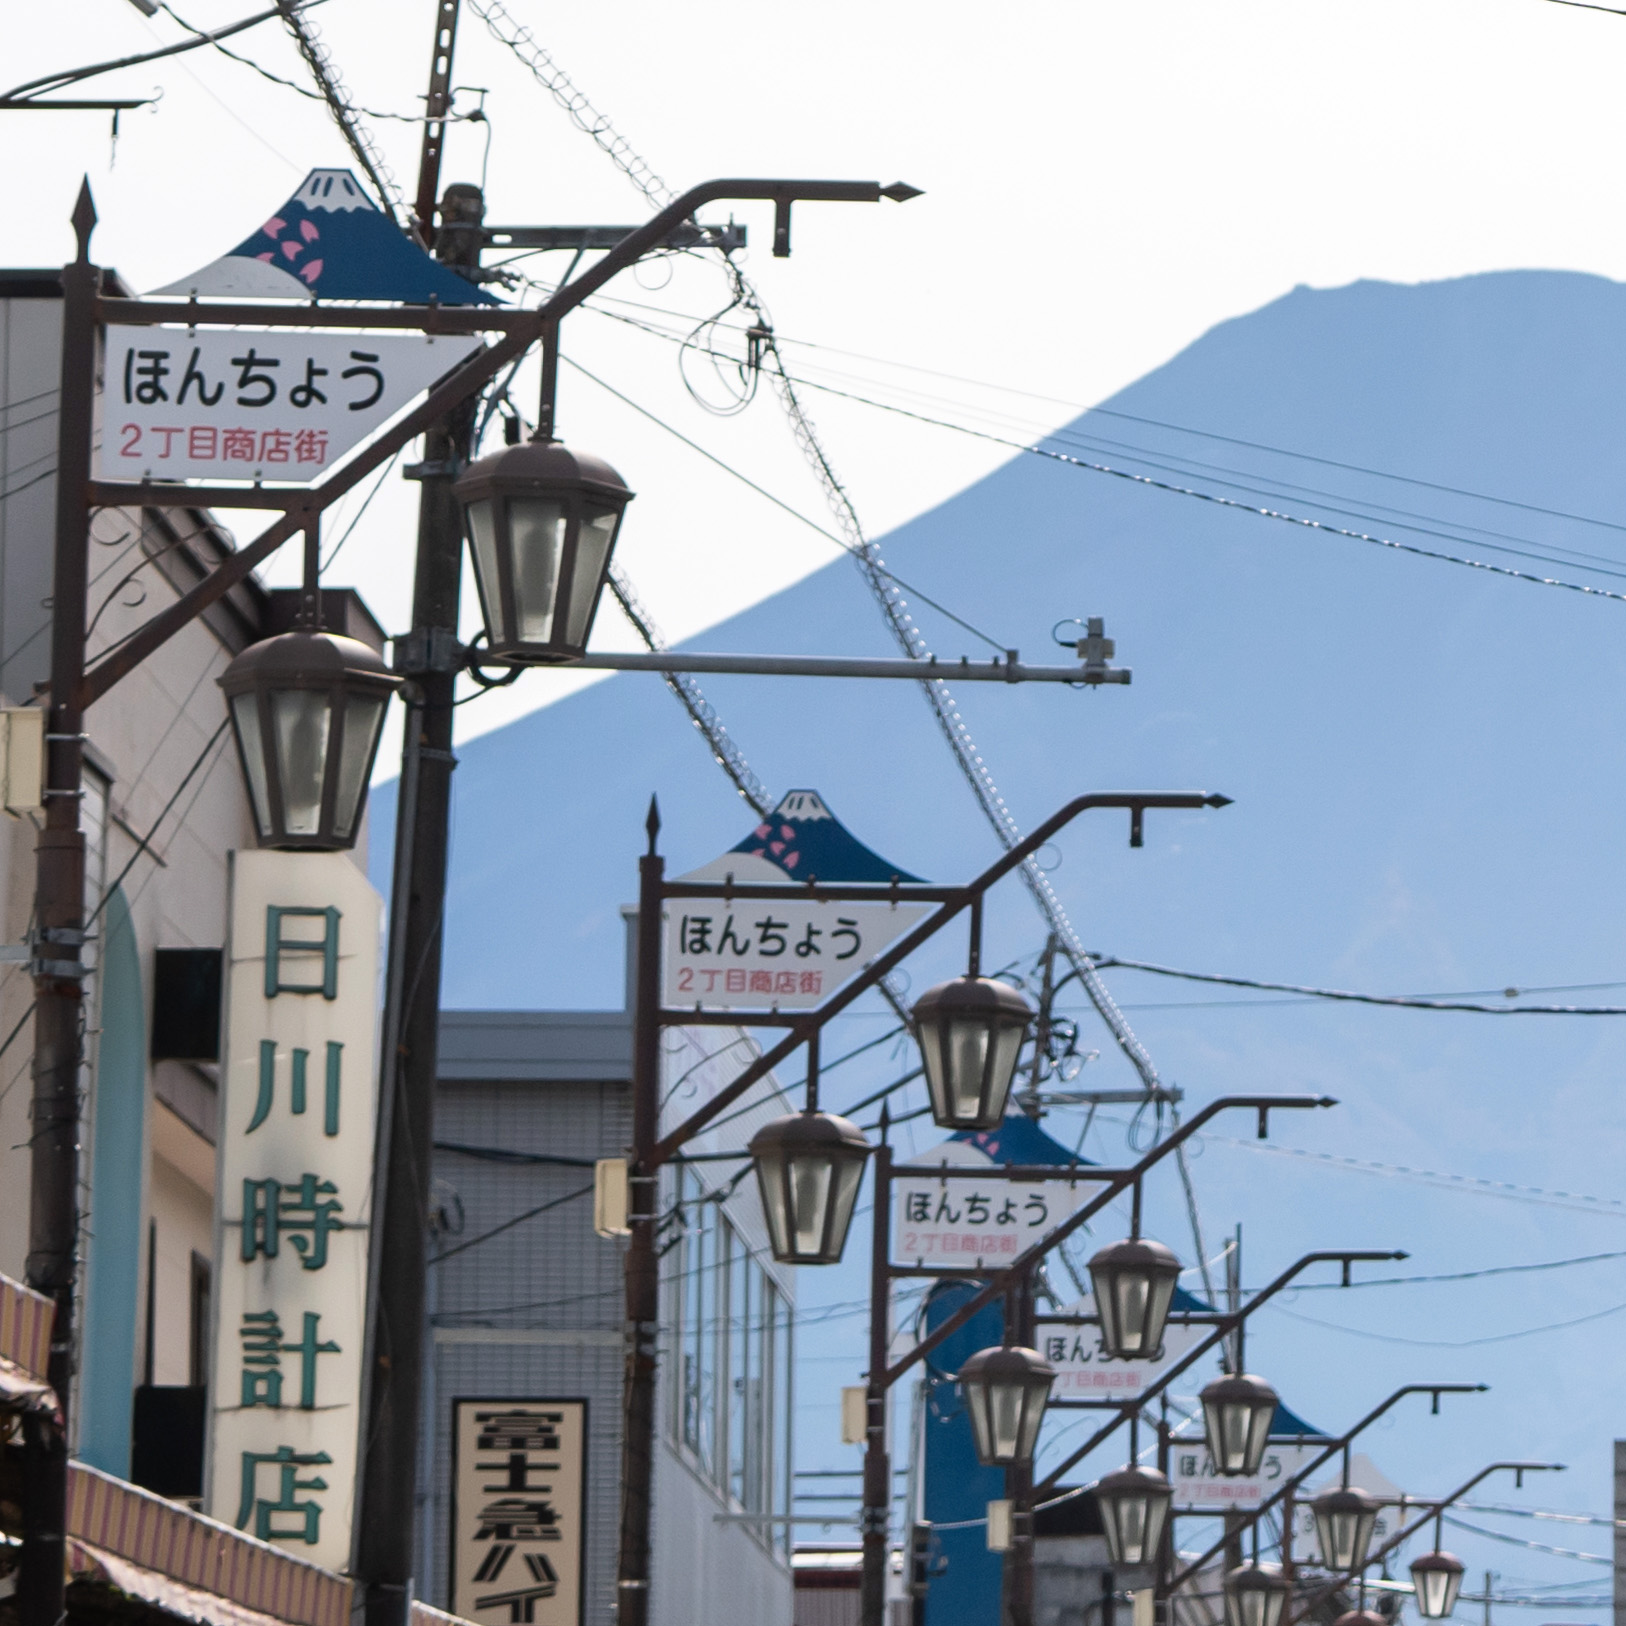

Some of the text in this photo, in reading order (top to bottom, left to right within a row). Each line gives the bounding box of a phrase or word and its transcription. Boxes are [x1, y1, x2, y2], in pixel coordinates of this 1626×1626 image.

[122, 346, 387, 412] ほんちょう
[119, 423, 330, 467] 2丁目商店街
[678, 914, 864, 961] ほんちょう
[677, 967, 823, 996] 2丁目商店街
[235, 903, 344, 1546] 日川時計店
[905, 1190, 1049, 1228] ほんちょう
[904, 1231, 1018, 1256] 2丁目商店街
[1061, 1371, 1141, 1388] 丁目商店街
